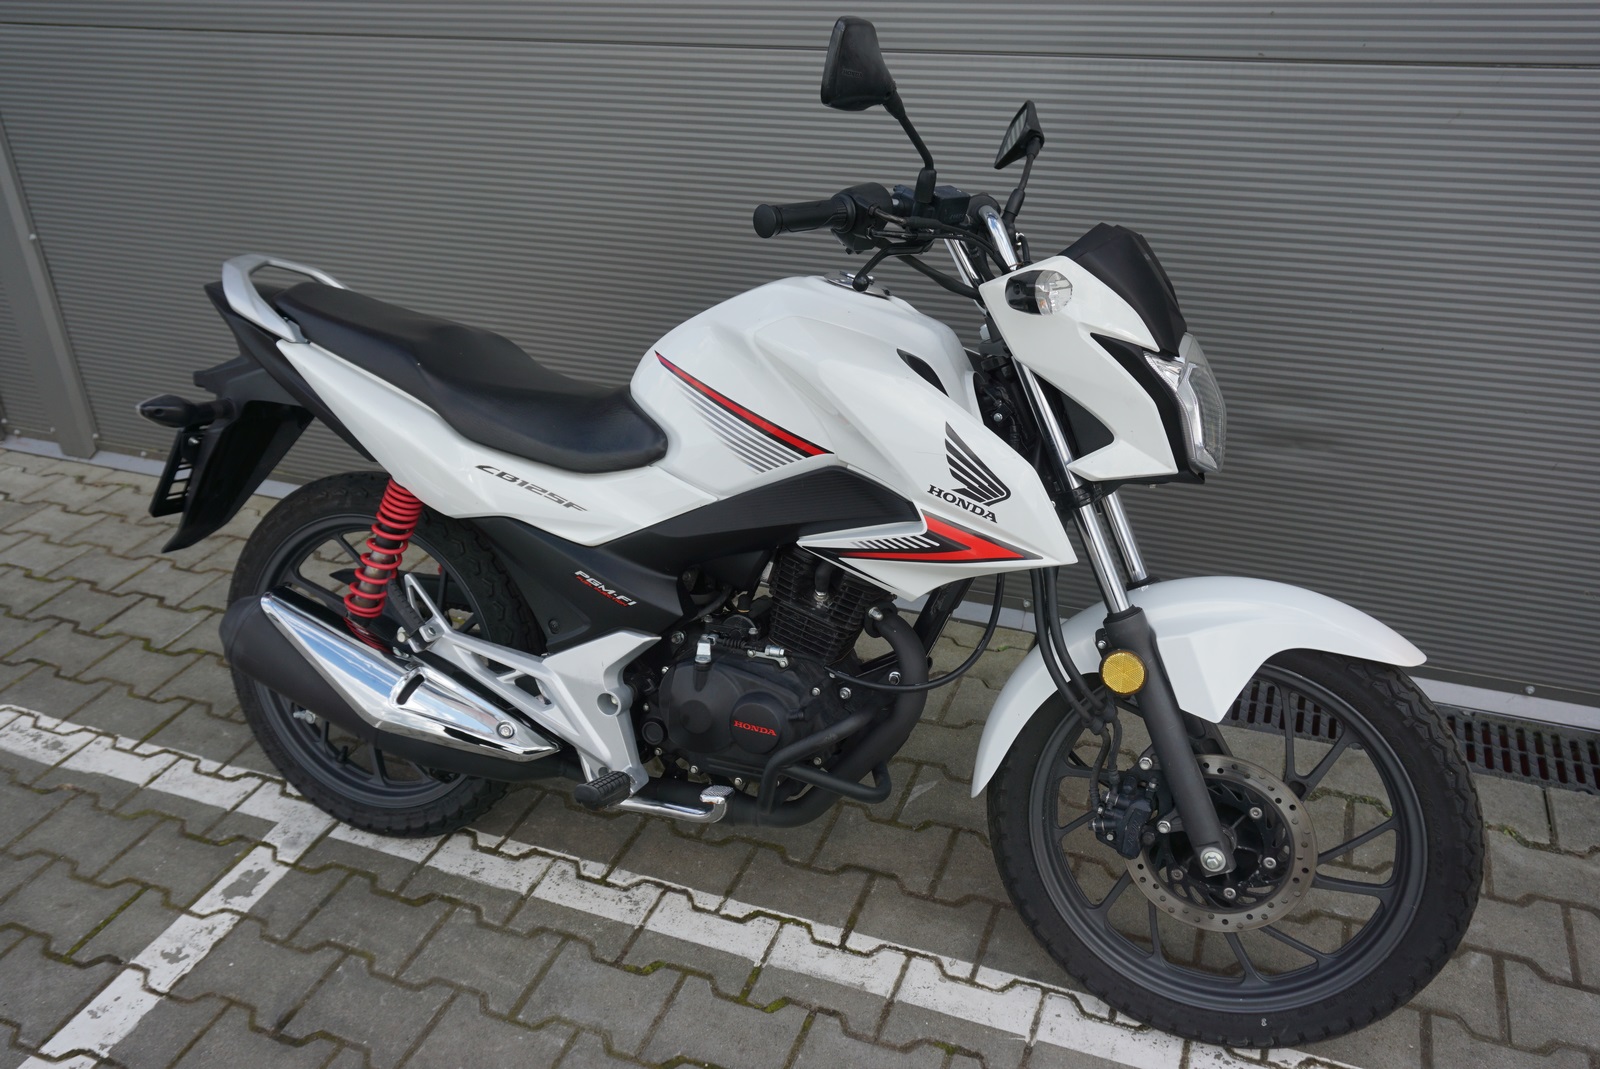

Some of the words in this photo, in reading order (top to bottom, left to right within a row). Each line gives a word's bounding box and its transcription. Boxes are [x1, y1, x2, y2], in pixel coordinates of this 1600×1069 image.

[475, 464, 588, 512] CB125F
[927, 484, 998, 523] HONDA
[733, 720, 777, 736] HONDA
